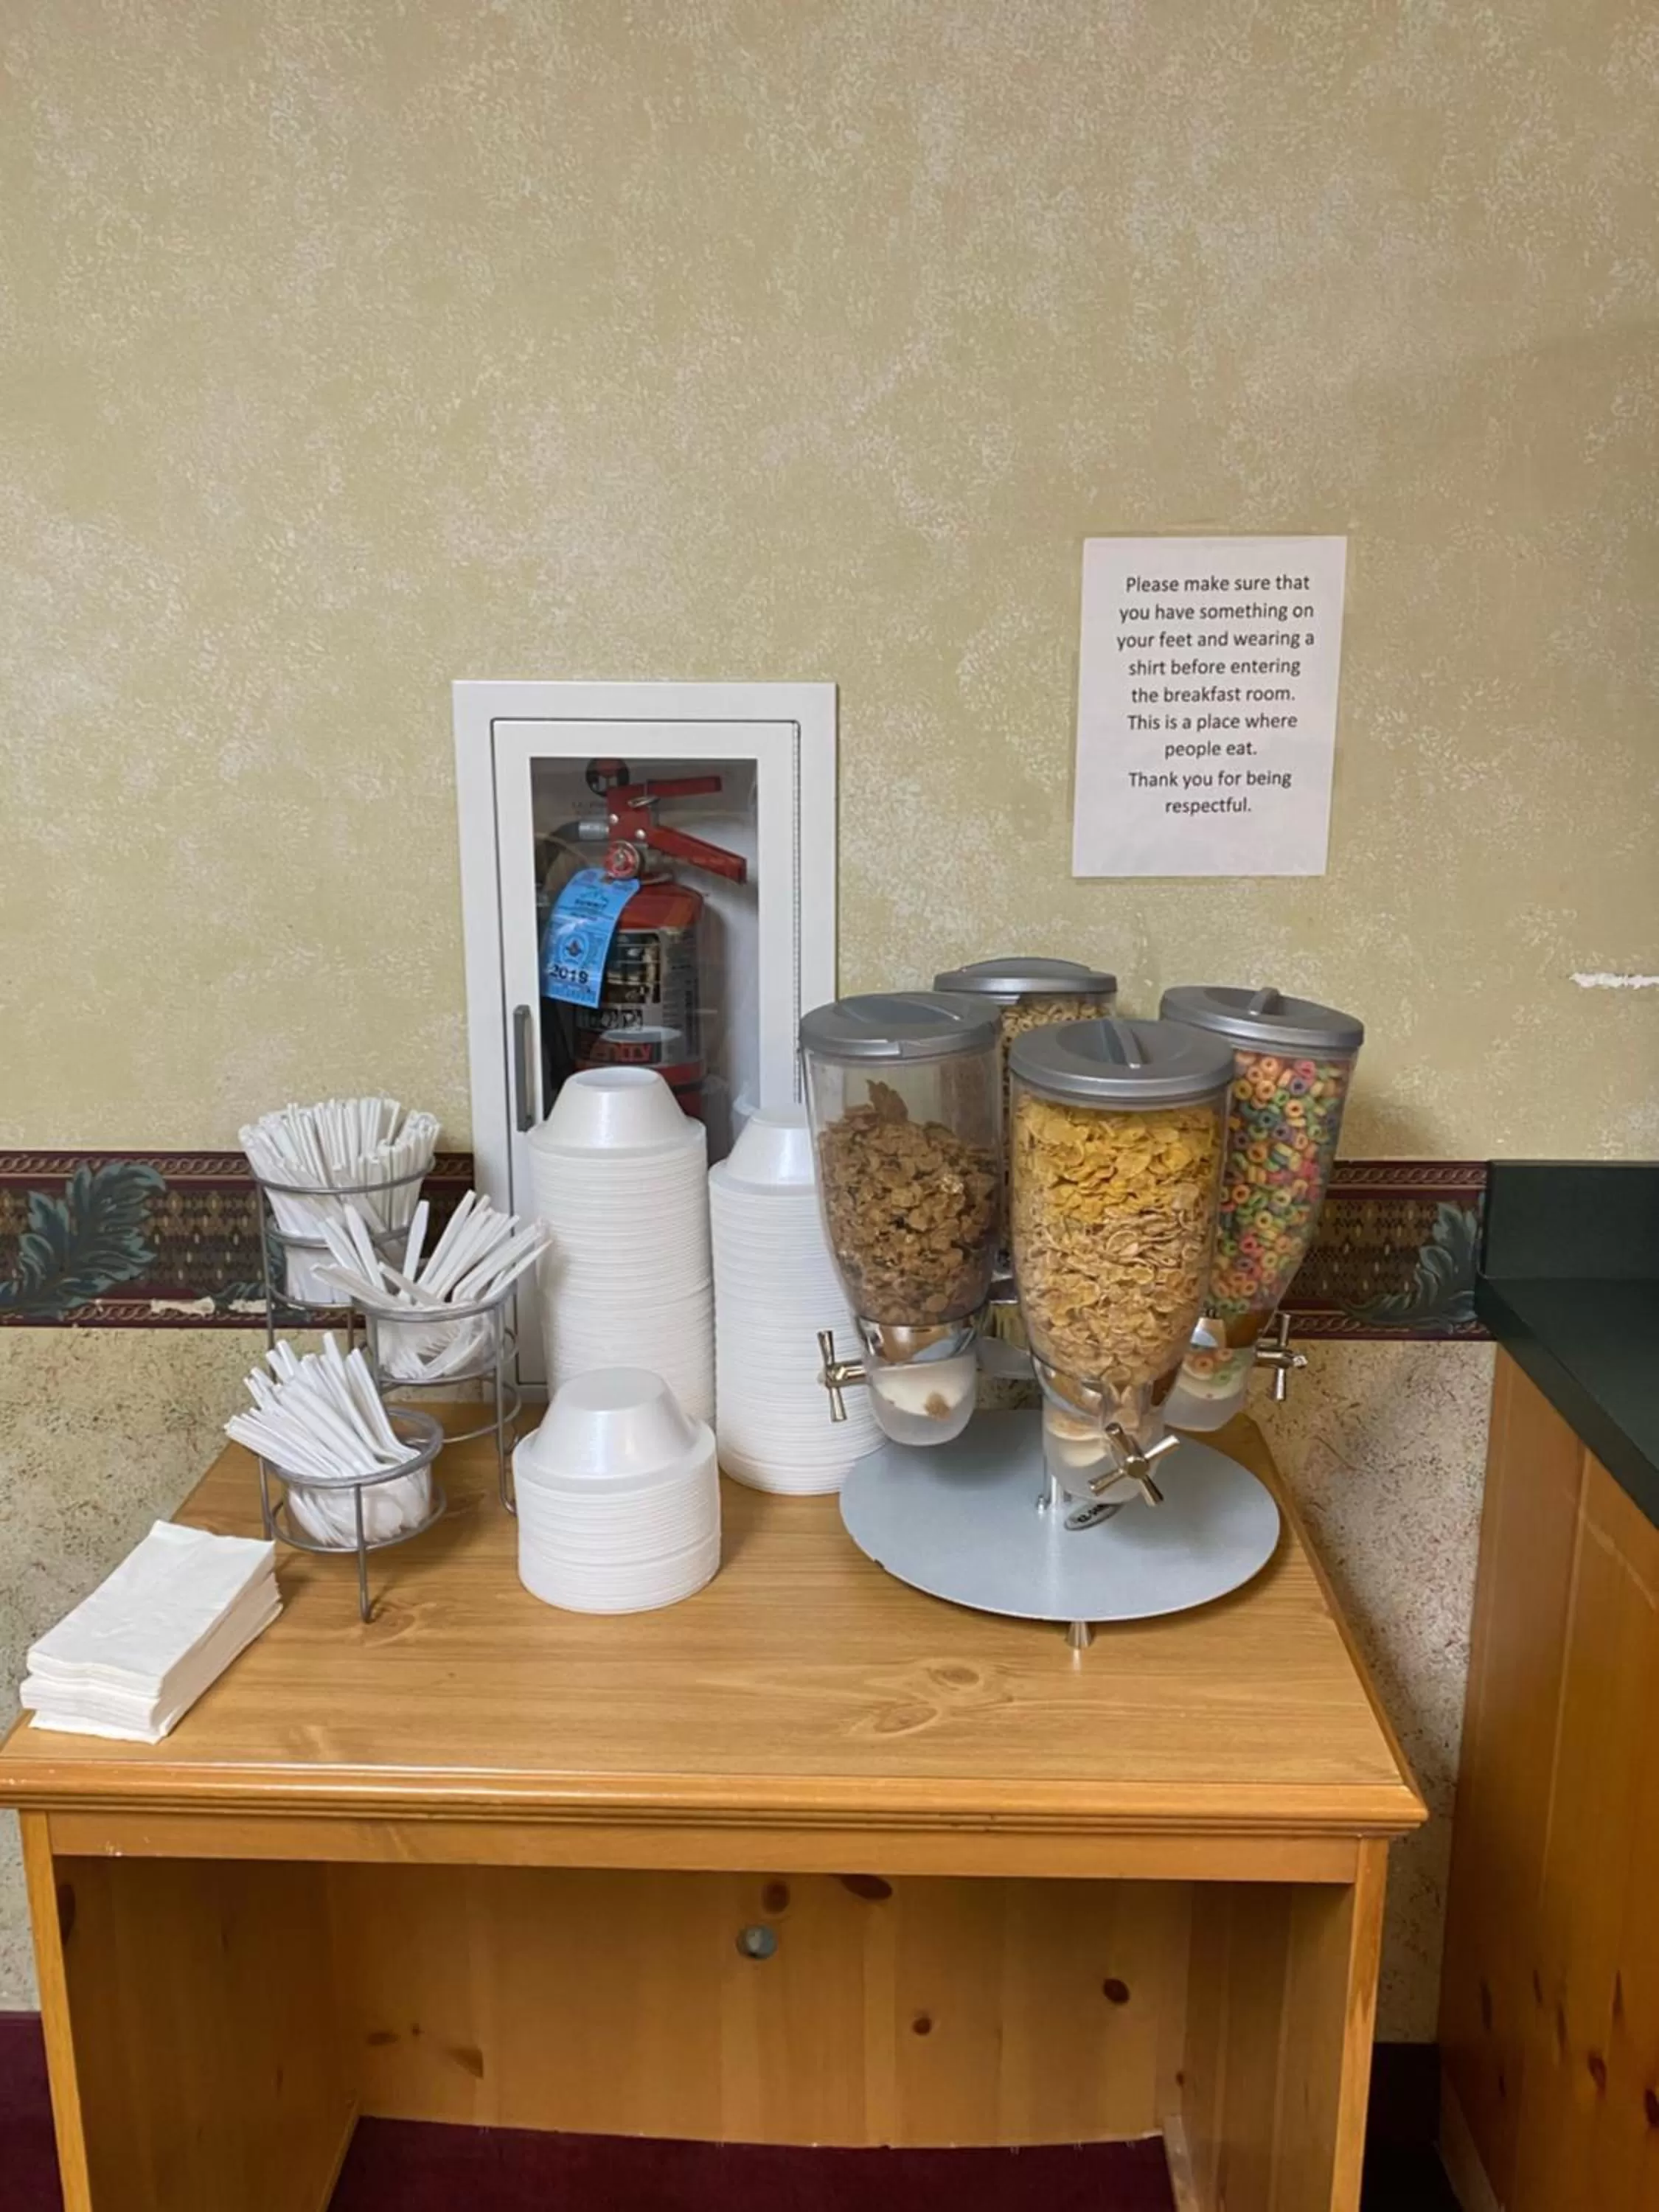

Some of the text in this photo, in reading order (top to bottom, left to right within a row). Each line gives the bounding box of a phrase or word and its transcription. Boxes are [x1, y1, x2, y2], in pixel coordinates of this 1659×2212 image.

[1126, 574, 1310, 593] Please make sure that
[1119, 602, 1314, 624] you have something on
[1116, 630, 1315, 652] your feet and wearing a
[1128, 658, 1301, 677] shirt before entering
[1132, 685, 1295, 703] the breakfast room.
[1127, 712, 1298, 733] This is a place where
[1165, 740, 1258, 760] people eat.
[1127, 769, 1293, 790] Thank you for being
[1165, 796, 1251, 816] respectful.
[549, 964, 588, 984] 2019
